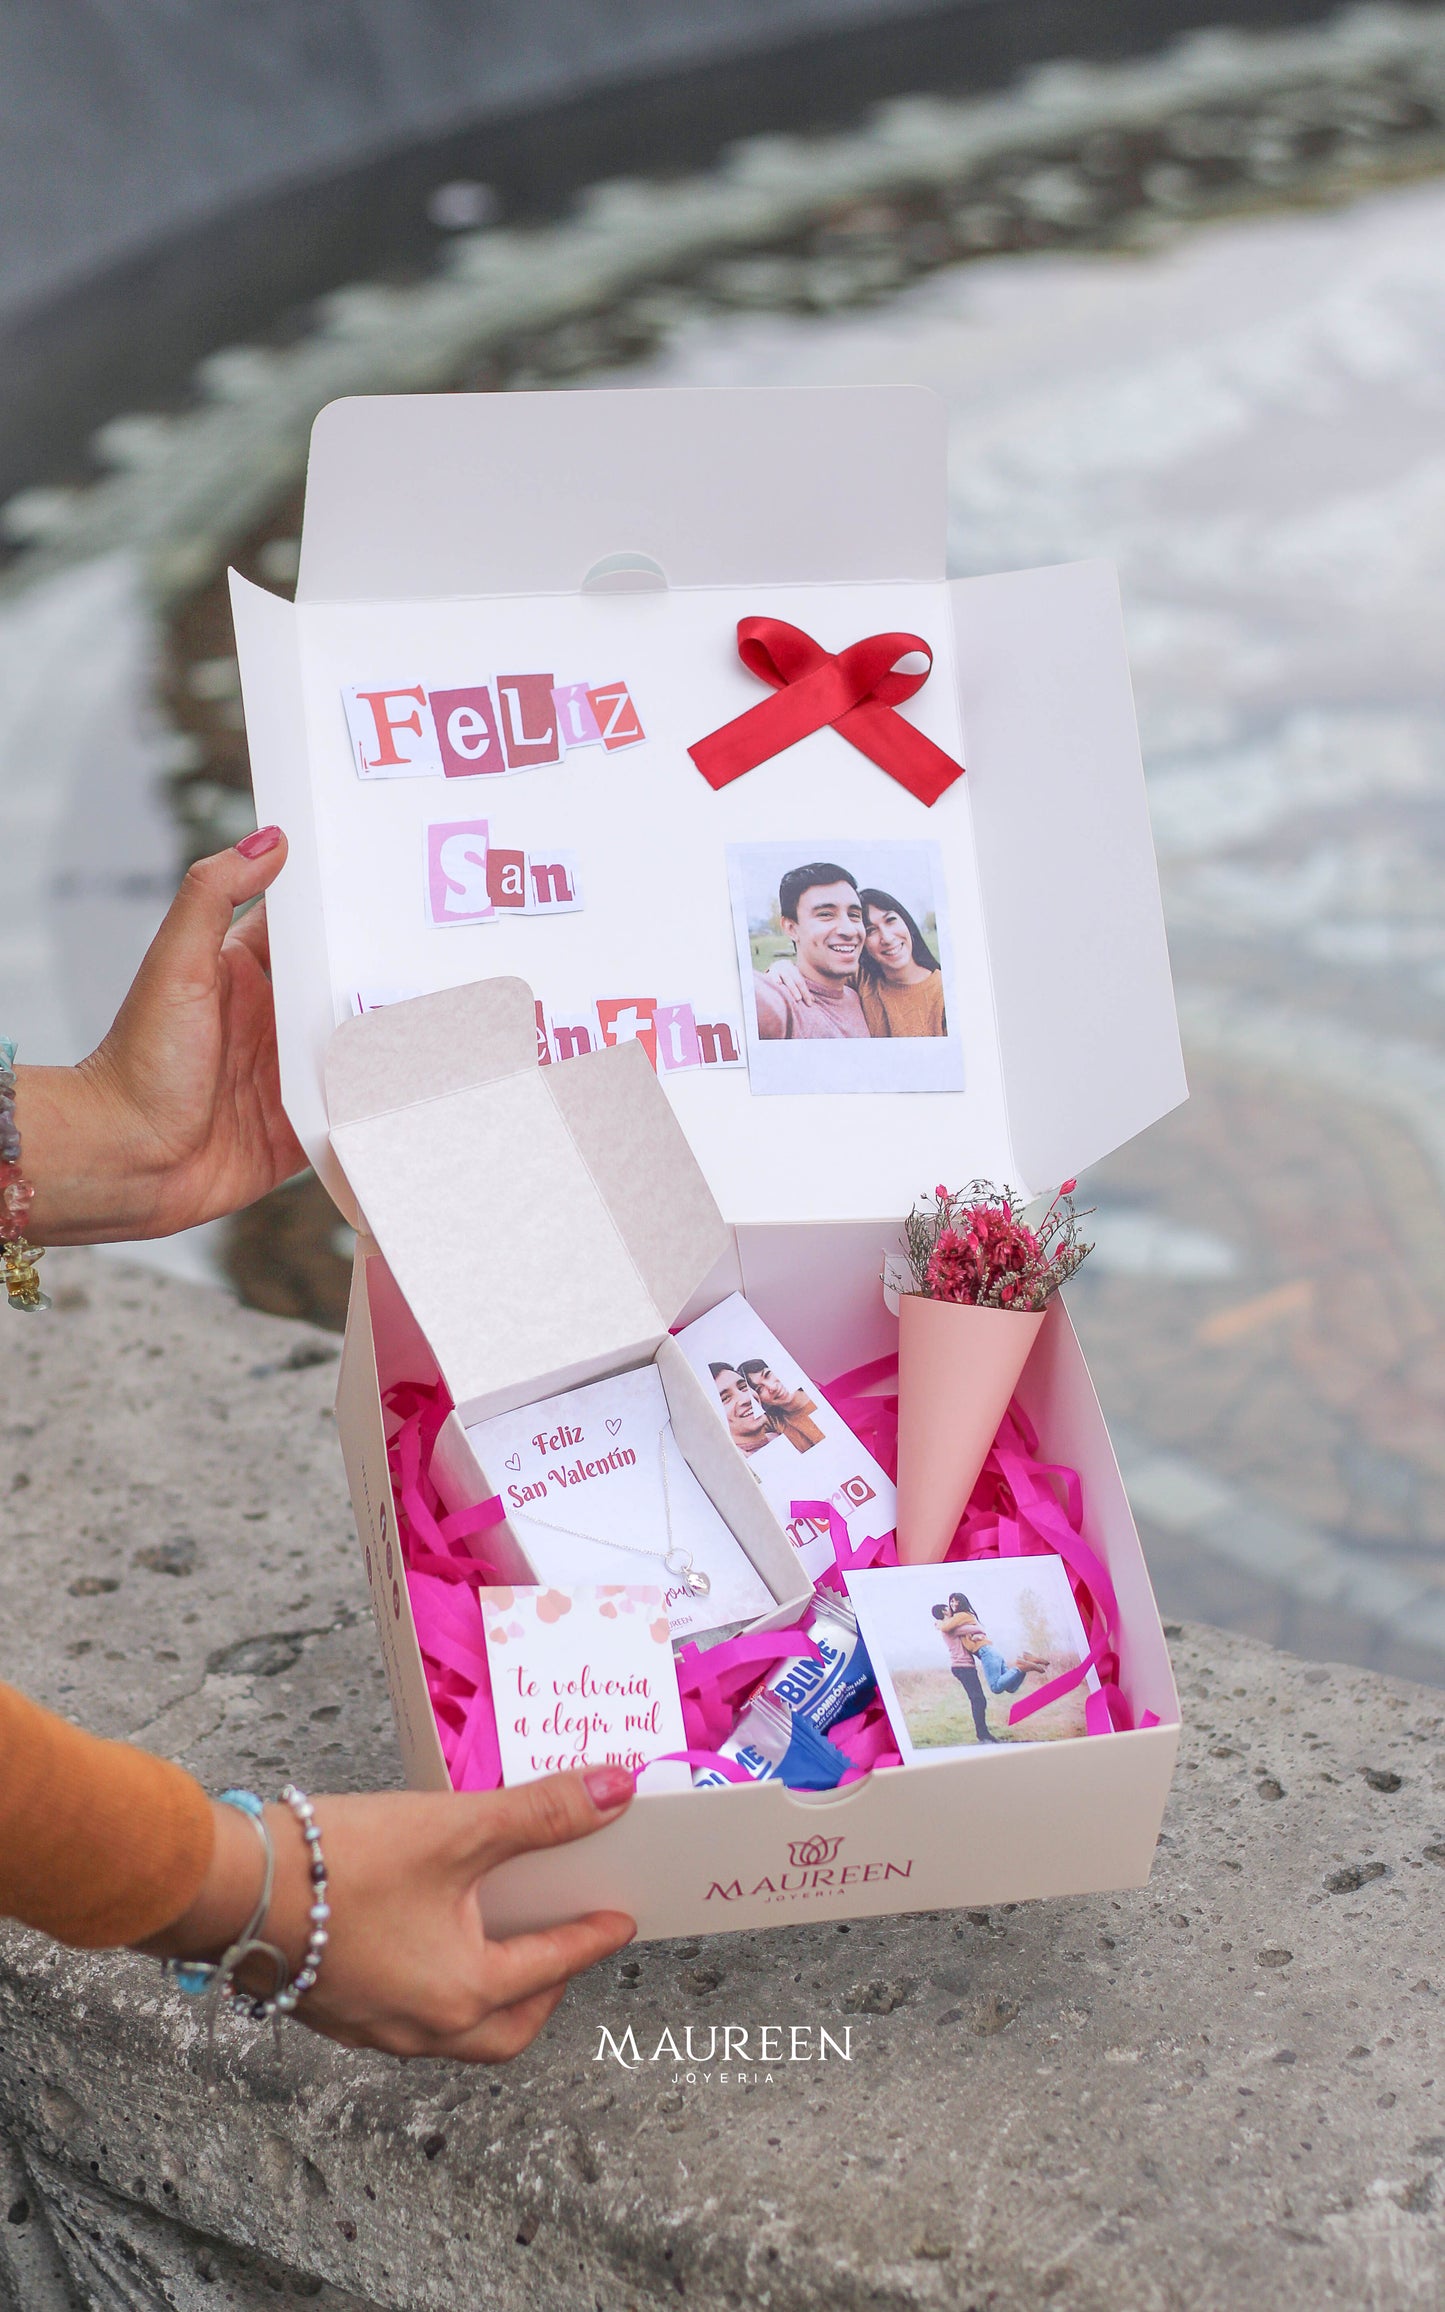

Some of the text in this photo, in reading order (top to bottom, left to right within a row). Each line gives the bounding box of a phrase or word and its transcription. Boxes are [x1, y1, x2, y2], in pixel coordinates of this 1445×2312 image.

[440, 833, 574, 914] San
[532, 1426, 584, 1455] Feliz
[507, 1447, 636, 1508] San Valentín
[553, 1665, 651, 1698] volvería
[775, 1640, 838, 1705] BLIME
[811, 1681, 847, 1723] BOMBÓN
[514, 1701, 662, 1752] a elegir mil
[531, 1752, 593, 1771] veces
[703, 1860, 913, 1900] MAUREEN
[764, 1888, 846, 1903] JOYERIA
